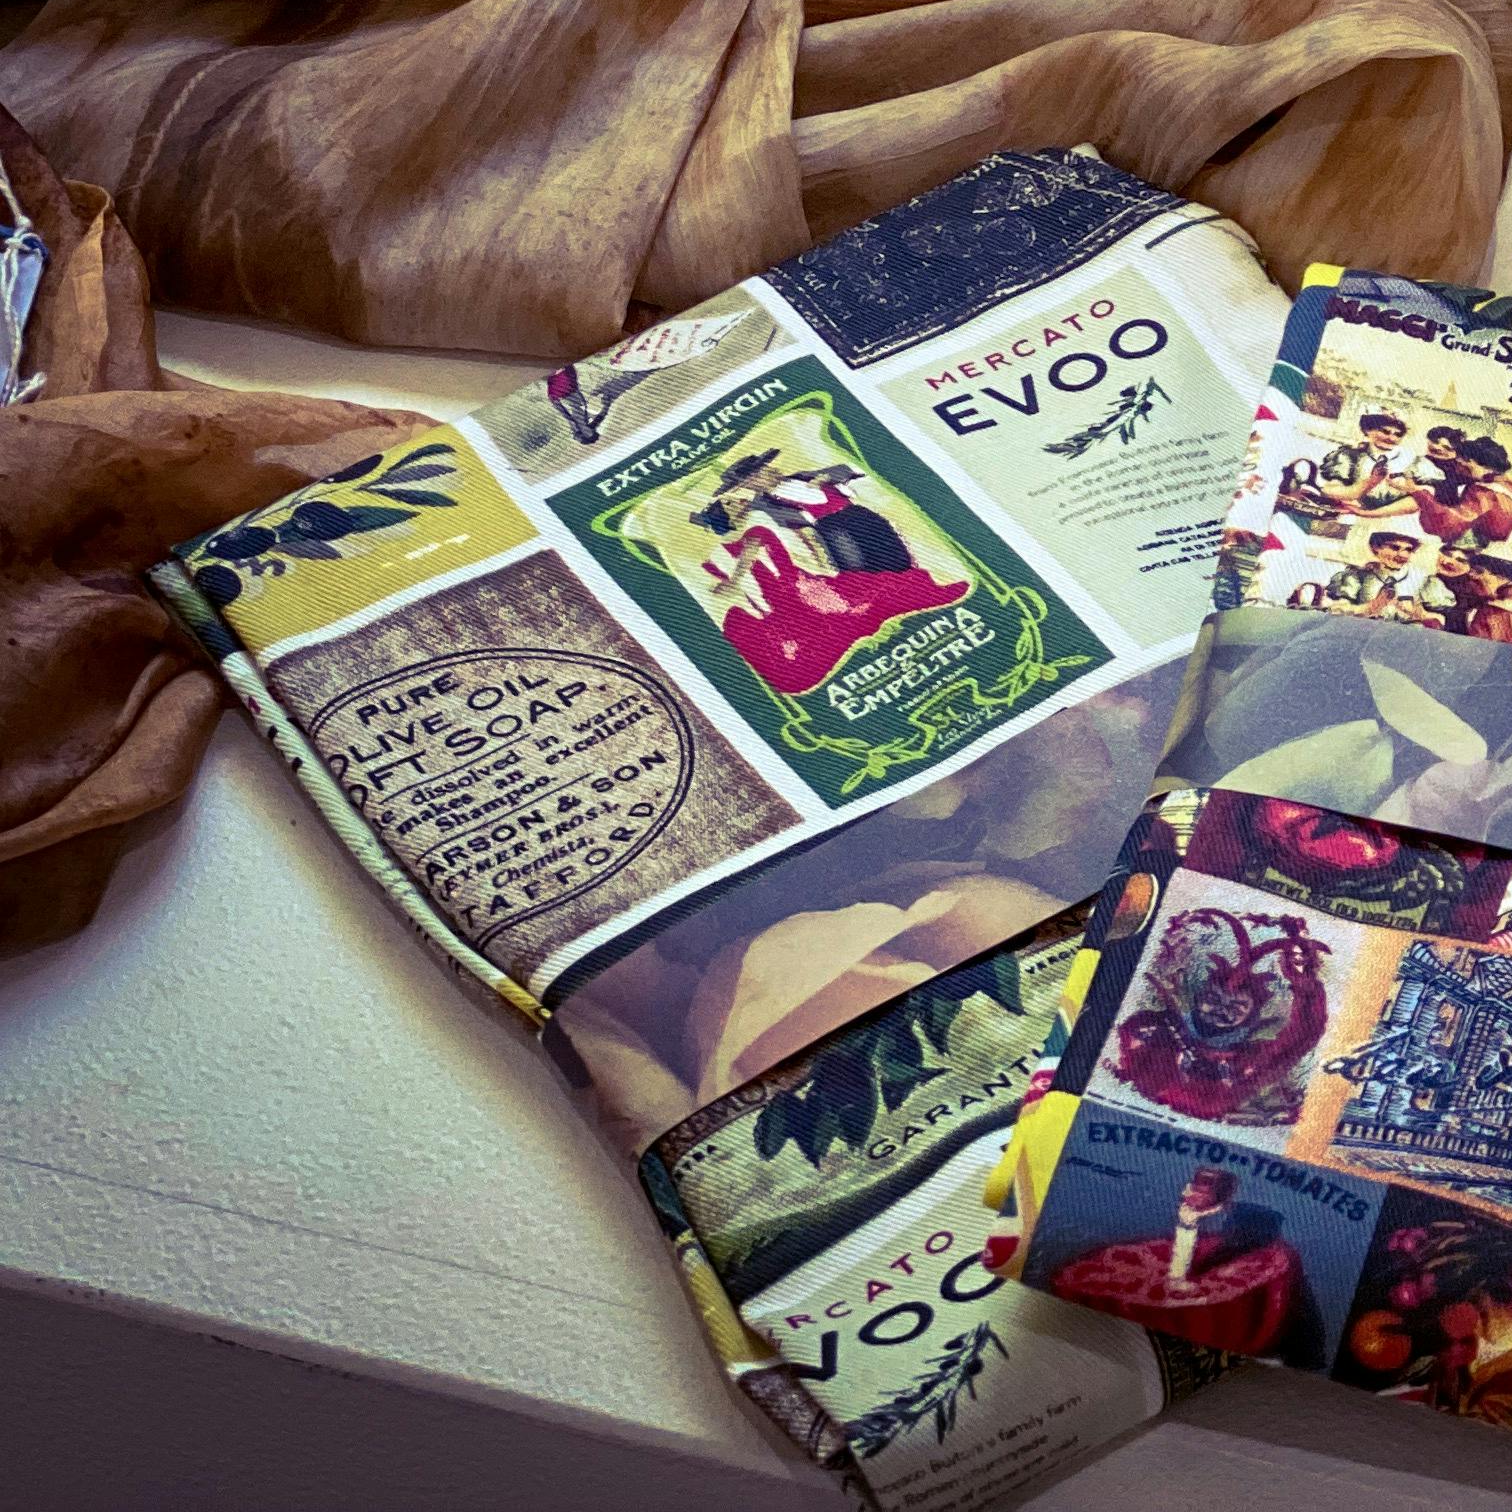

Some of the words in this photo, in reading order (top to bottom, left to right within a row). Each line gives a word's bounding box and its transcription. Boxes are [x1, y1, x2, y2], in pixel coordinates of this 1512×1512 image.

[924, 298, 1116, 392] MERCATO
[932, 318, 1170, 437] EVOO
[596, 439, 693, 497] EXTRA
[690, 377, 789, 440] VIRGIN
[356, 670, 462, 728] PURE
[467, 672, 551, 712] OIL
[827, 606, 983, 708] ARBEQUINA
[837, 620, 997, 721] EMPELTRE
[396, 791, 474, 835] makes
[493, 768, 526, 790] an
[544, 702, 655, 767] excellent
[410, 749, 522, 806] dissolved
[534, 731, 561, 752] in
[571, 689, 642, 733] warm
[556, 794, 583, 814] &
[590, 749, 669, 795] SON
[1088, 1120, 1228, 1165] EXTRACTO
